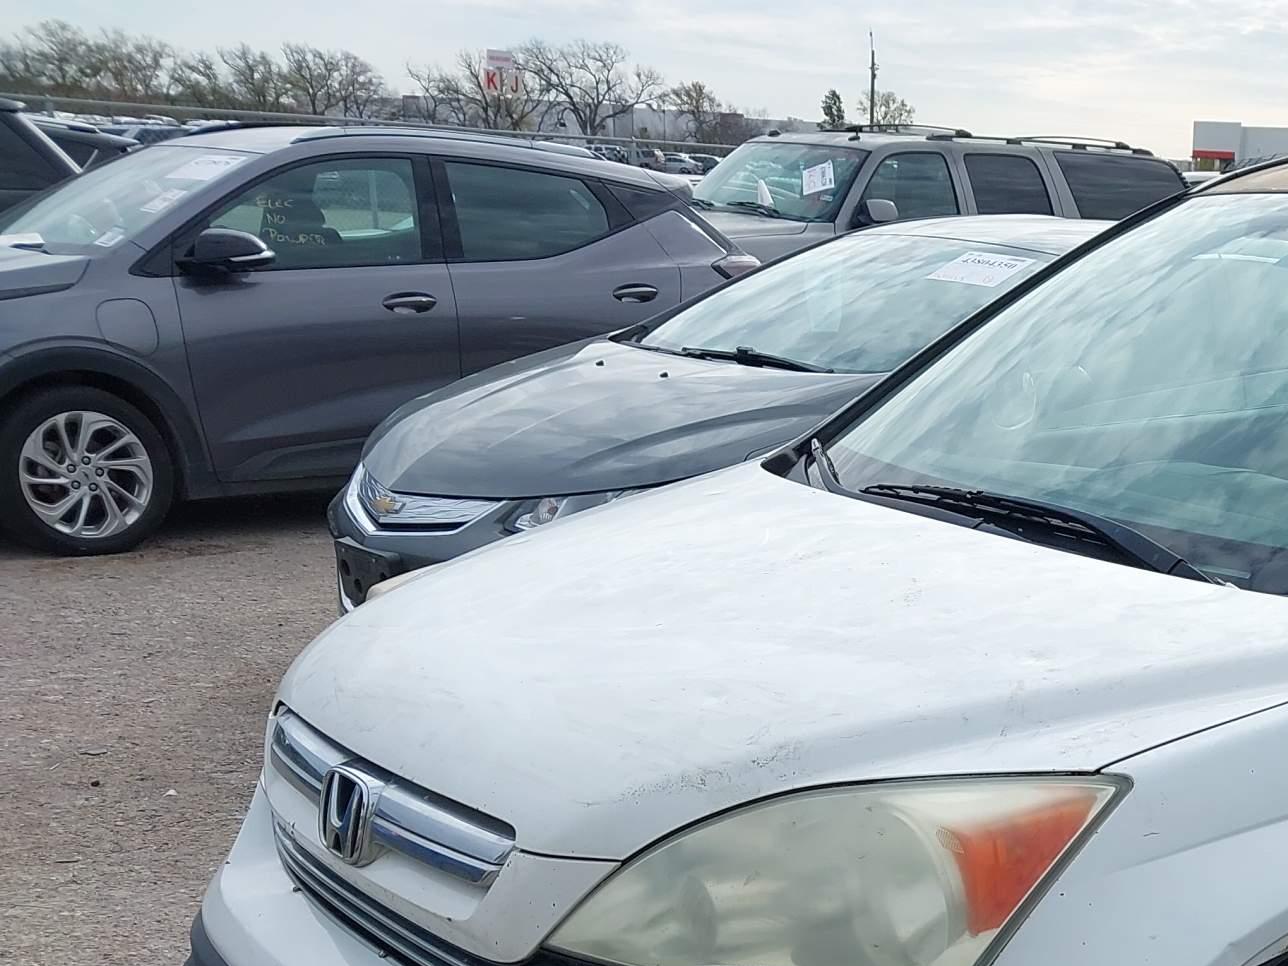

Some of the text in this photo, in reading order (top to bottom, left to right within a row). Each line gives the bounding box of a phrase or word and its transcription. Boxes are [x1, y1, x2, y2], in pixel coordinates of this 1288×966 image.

[486, 71, 498, 91] K
[511, 75, 518, 93] J
[266, 213, 286, 225] NO
